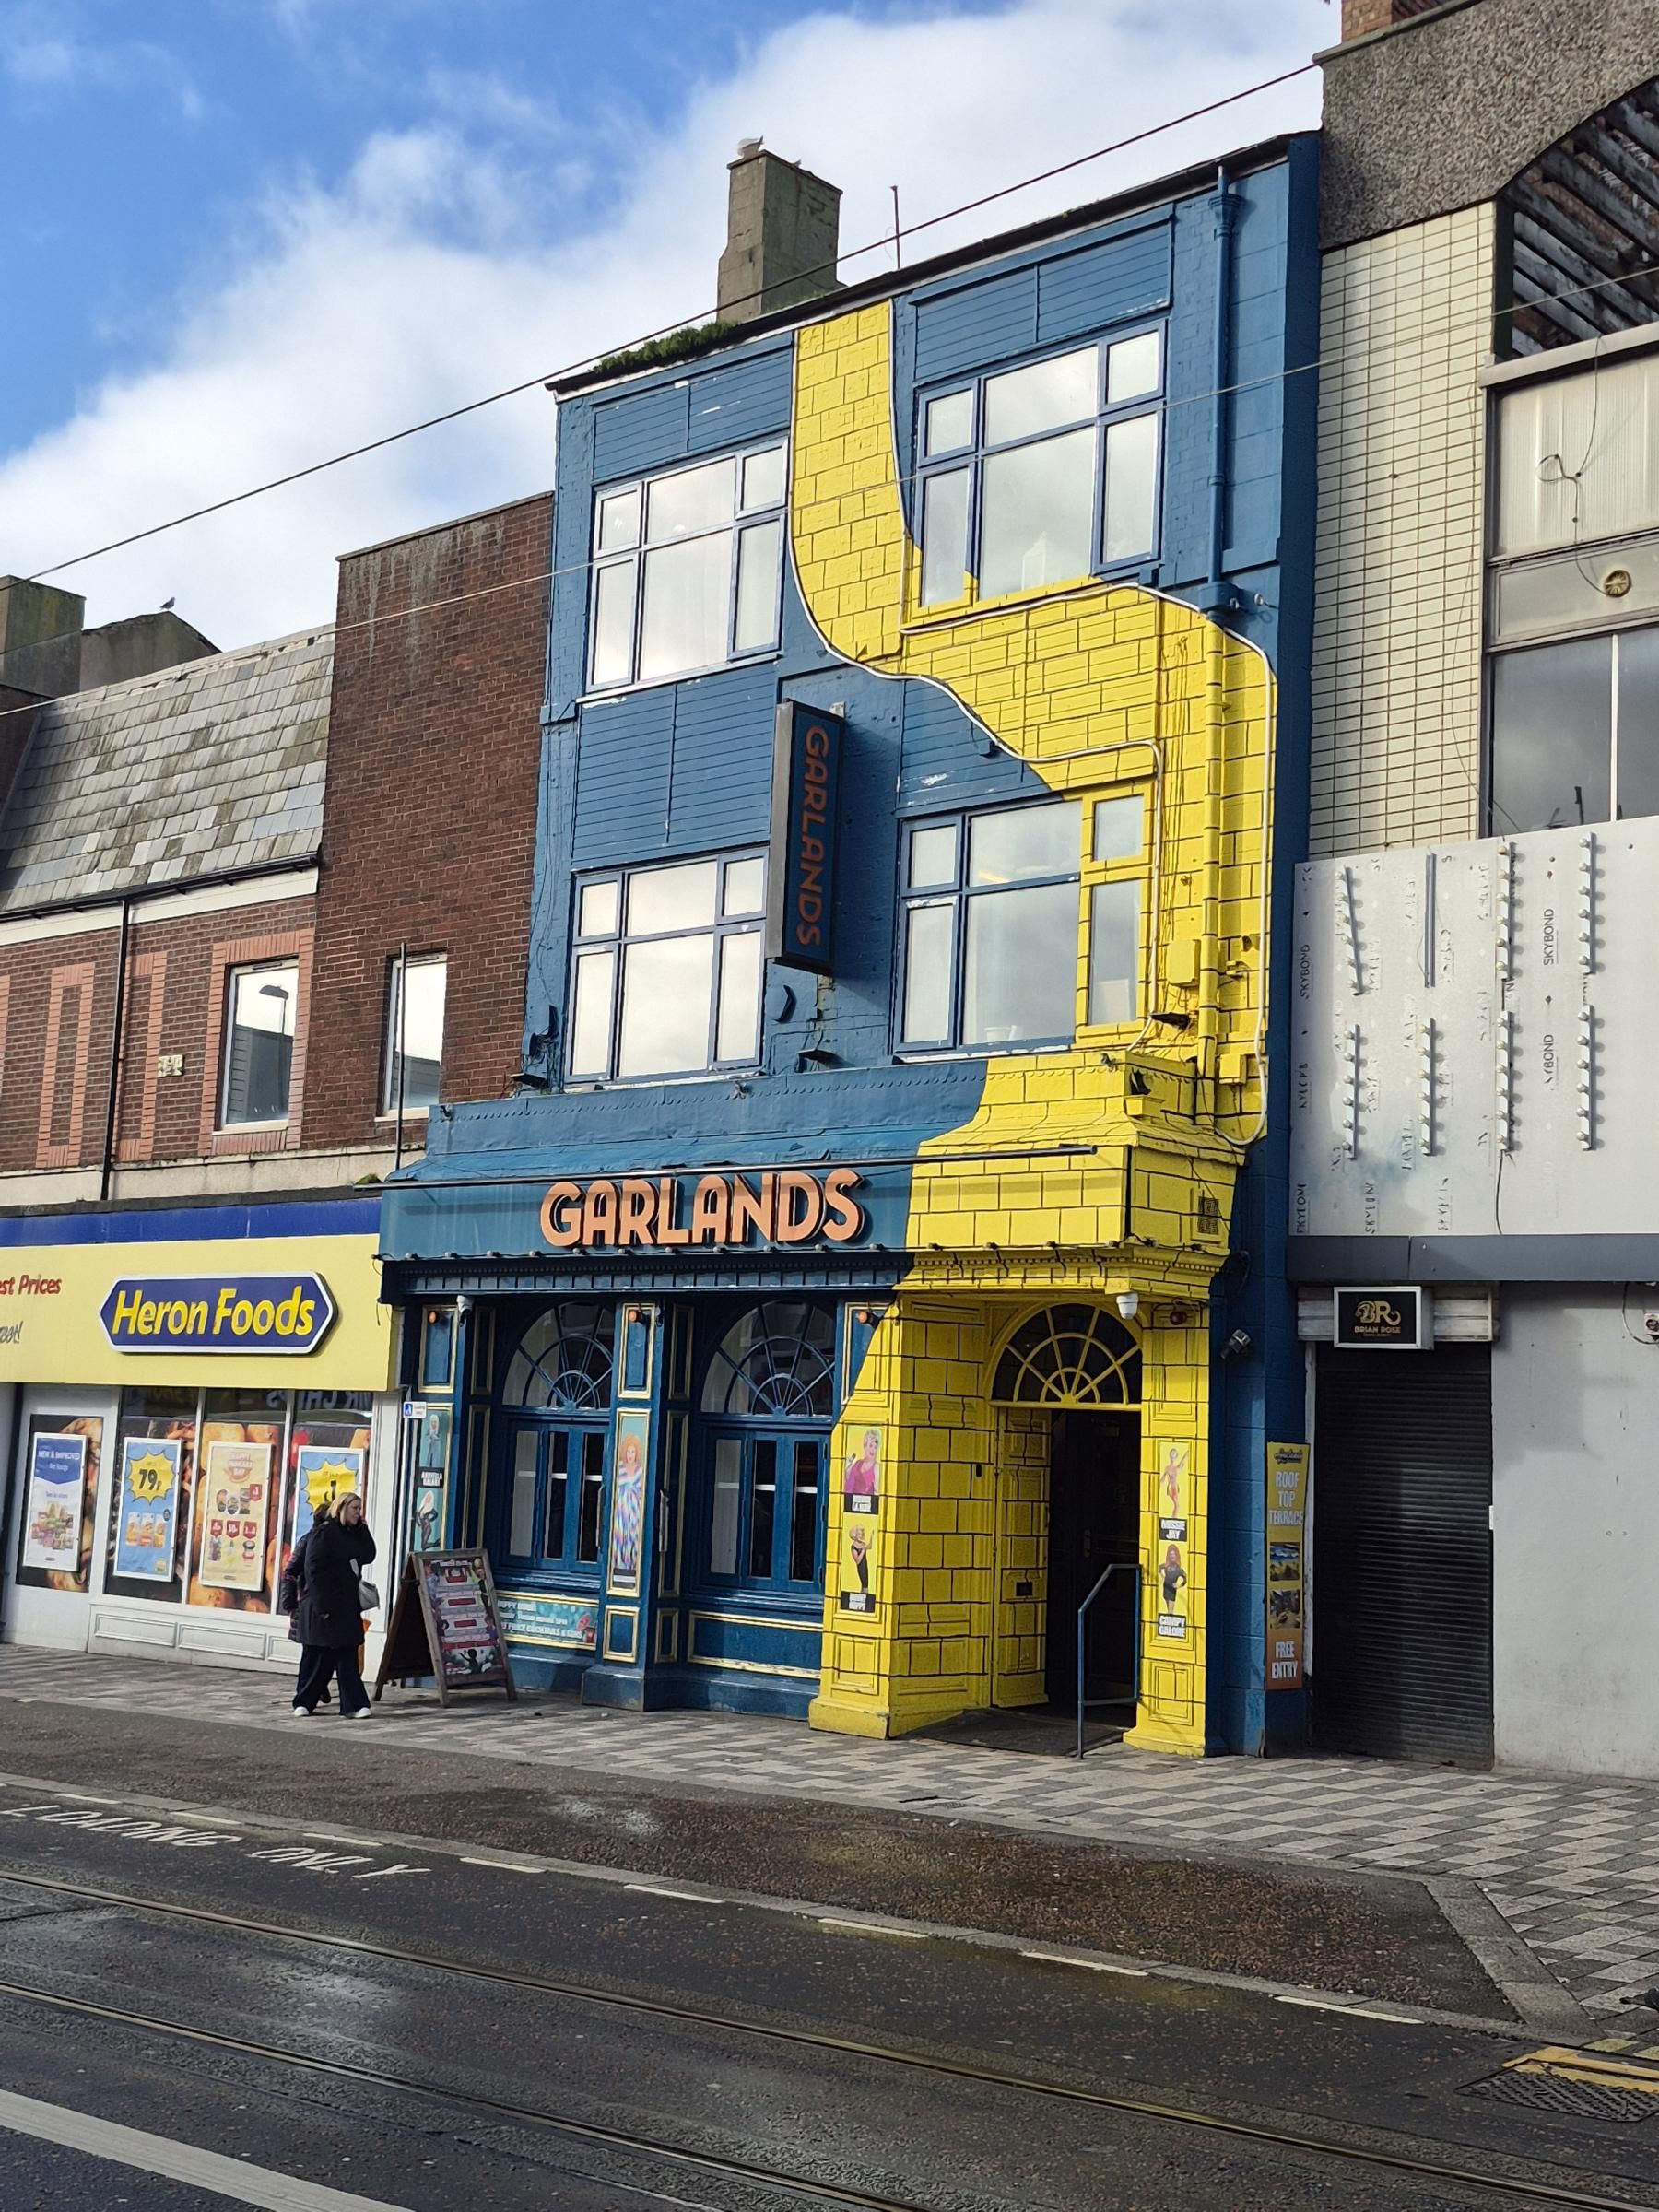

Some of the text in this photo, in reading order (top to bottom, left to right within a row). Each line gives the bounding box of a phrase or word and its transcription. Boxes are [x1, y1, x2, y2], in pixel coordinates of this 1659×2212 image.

[796, 724, 830, 947] GARLANDS
[1543, 908, 1554, 966] SKYBOND
[540, 1168, 865, 1246] GARLANDS
[18, 1274, 62, 1295] Prices
[112, 1286, 315, 1335] Heron Foods
[1354, 1325, 1402, 1334] BRIAN ROSE
[1275, 1471, 1299, 1488] ROOF
[1277, 1490, 1296, 1508] TOP
[1268, 1510, 1303, 1525] TERRACE
[1275, 1641, 1295, 1659] FREE
[1272, 1660, 1298, 1679] ENTRY
[0, 1805, 242, 1846] LOADING
[245, 1847, 432, 1878] ONLY
